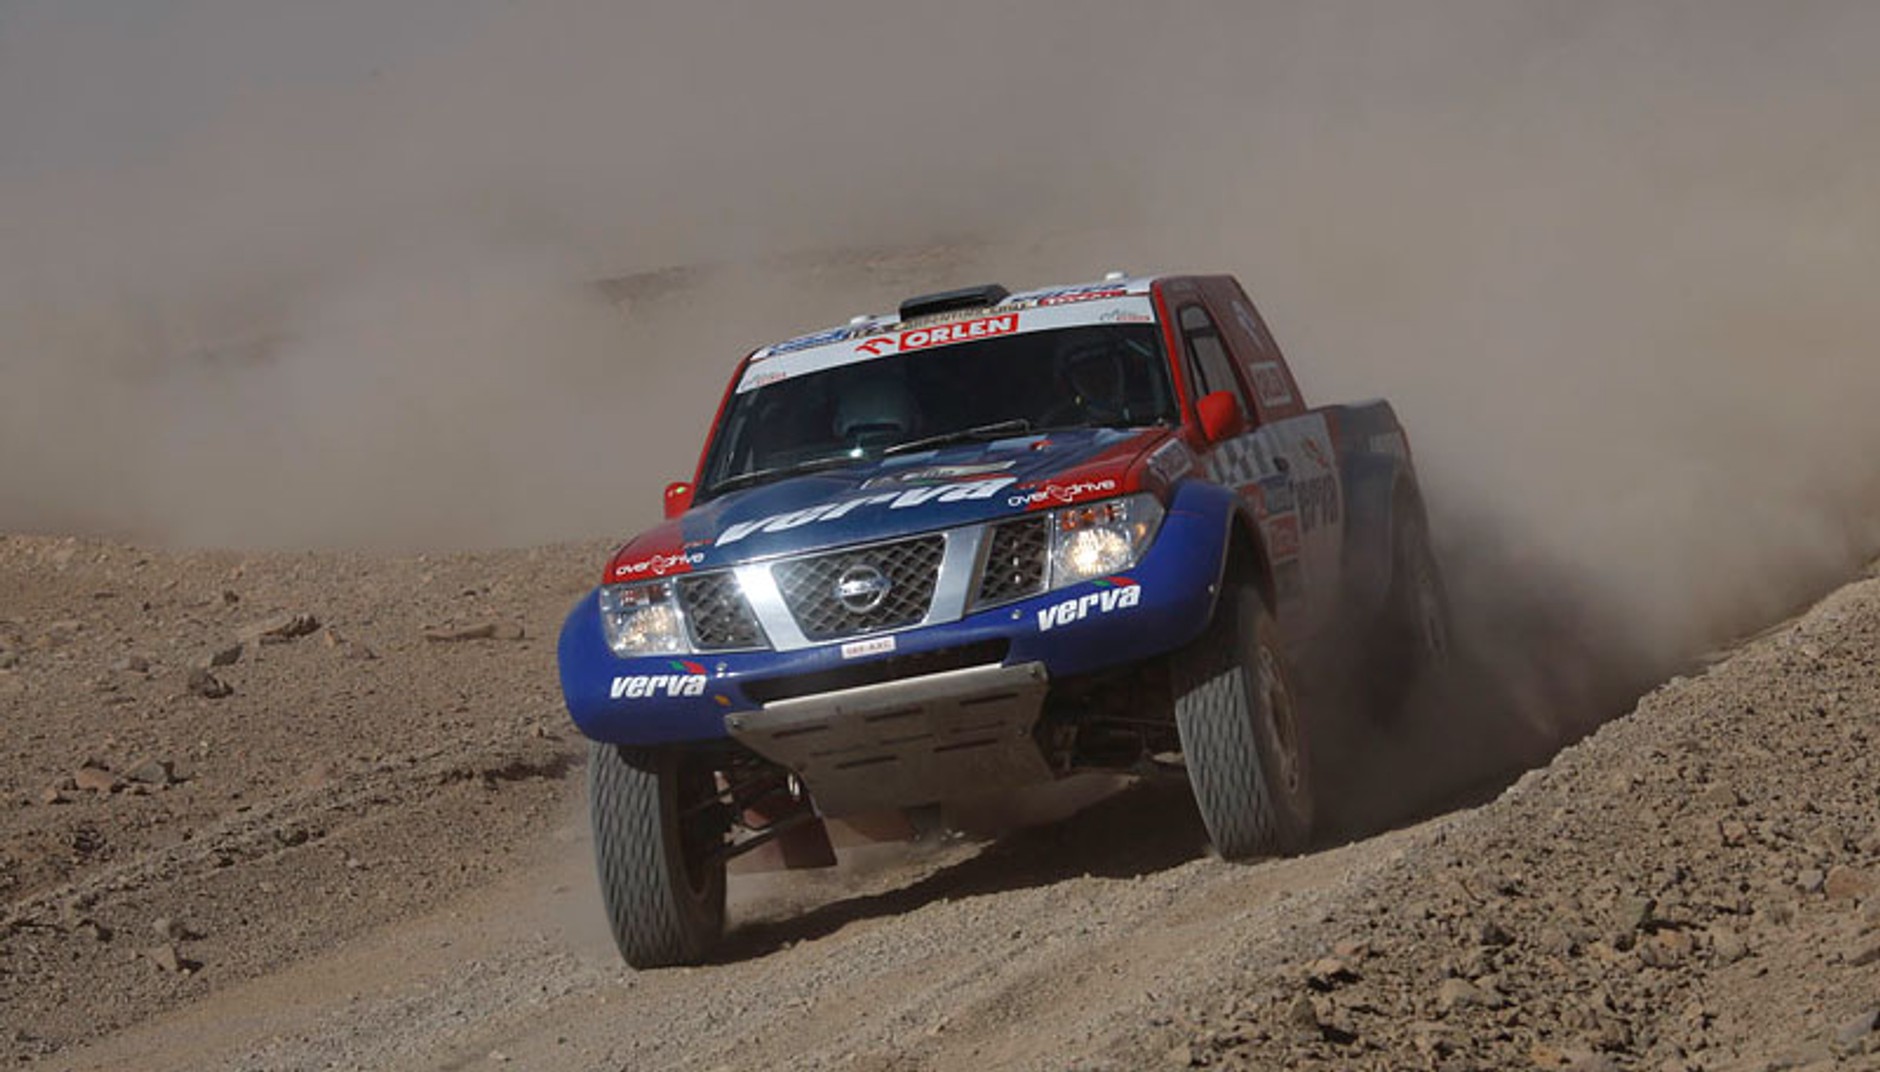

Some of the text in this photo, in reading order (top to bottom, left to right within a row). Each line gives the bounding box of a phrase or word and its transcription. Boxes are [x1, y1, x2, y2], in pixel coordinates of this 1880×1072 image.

[904, 317, 1012, 347] ORLEN
[714, 476, 1018, 547] verva
[1037, 584, 1141, 632] verva
[610, 674, 707, 699] verva
